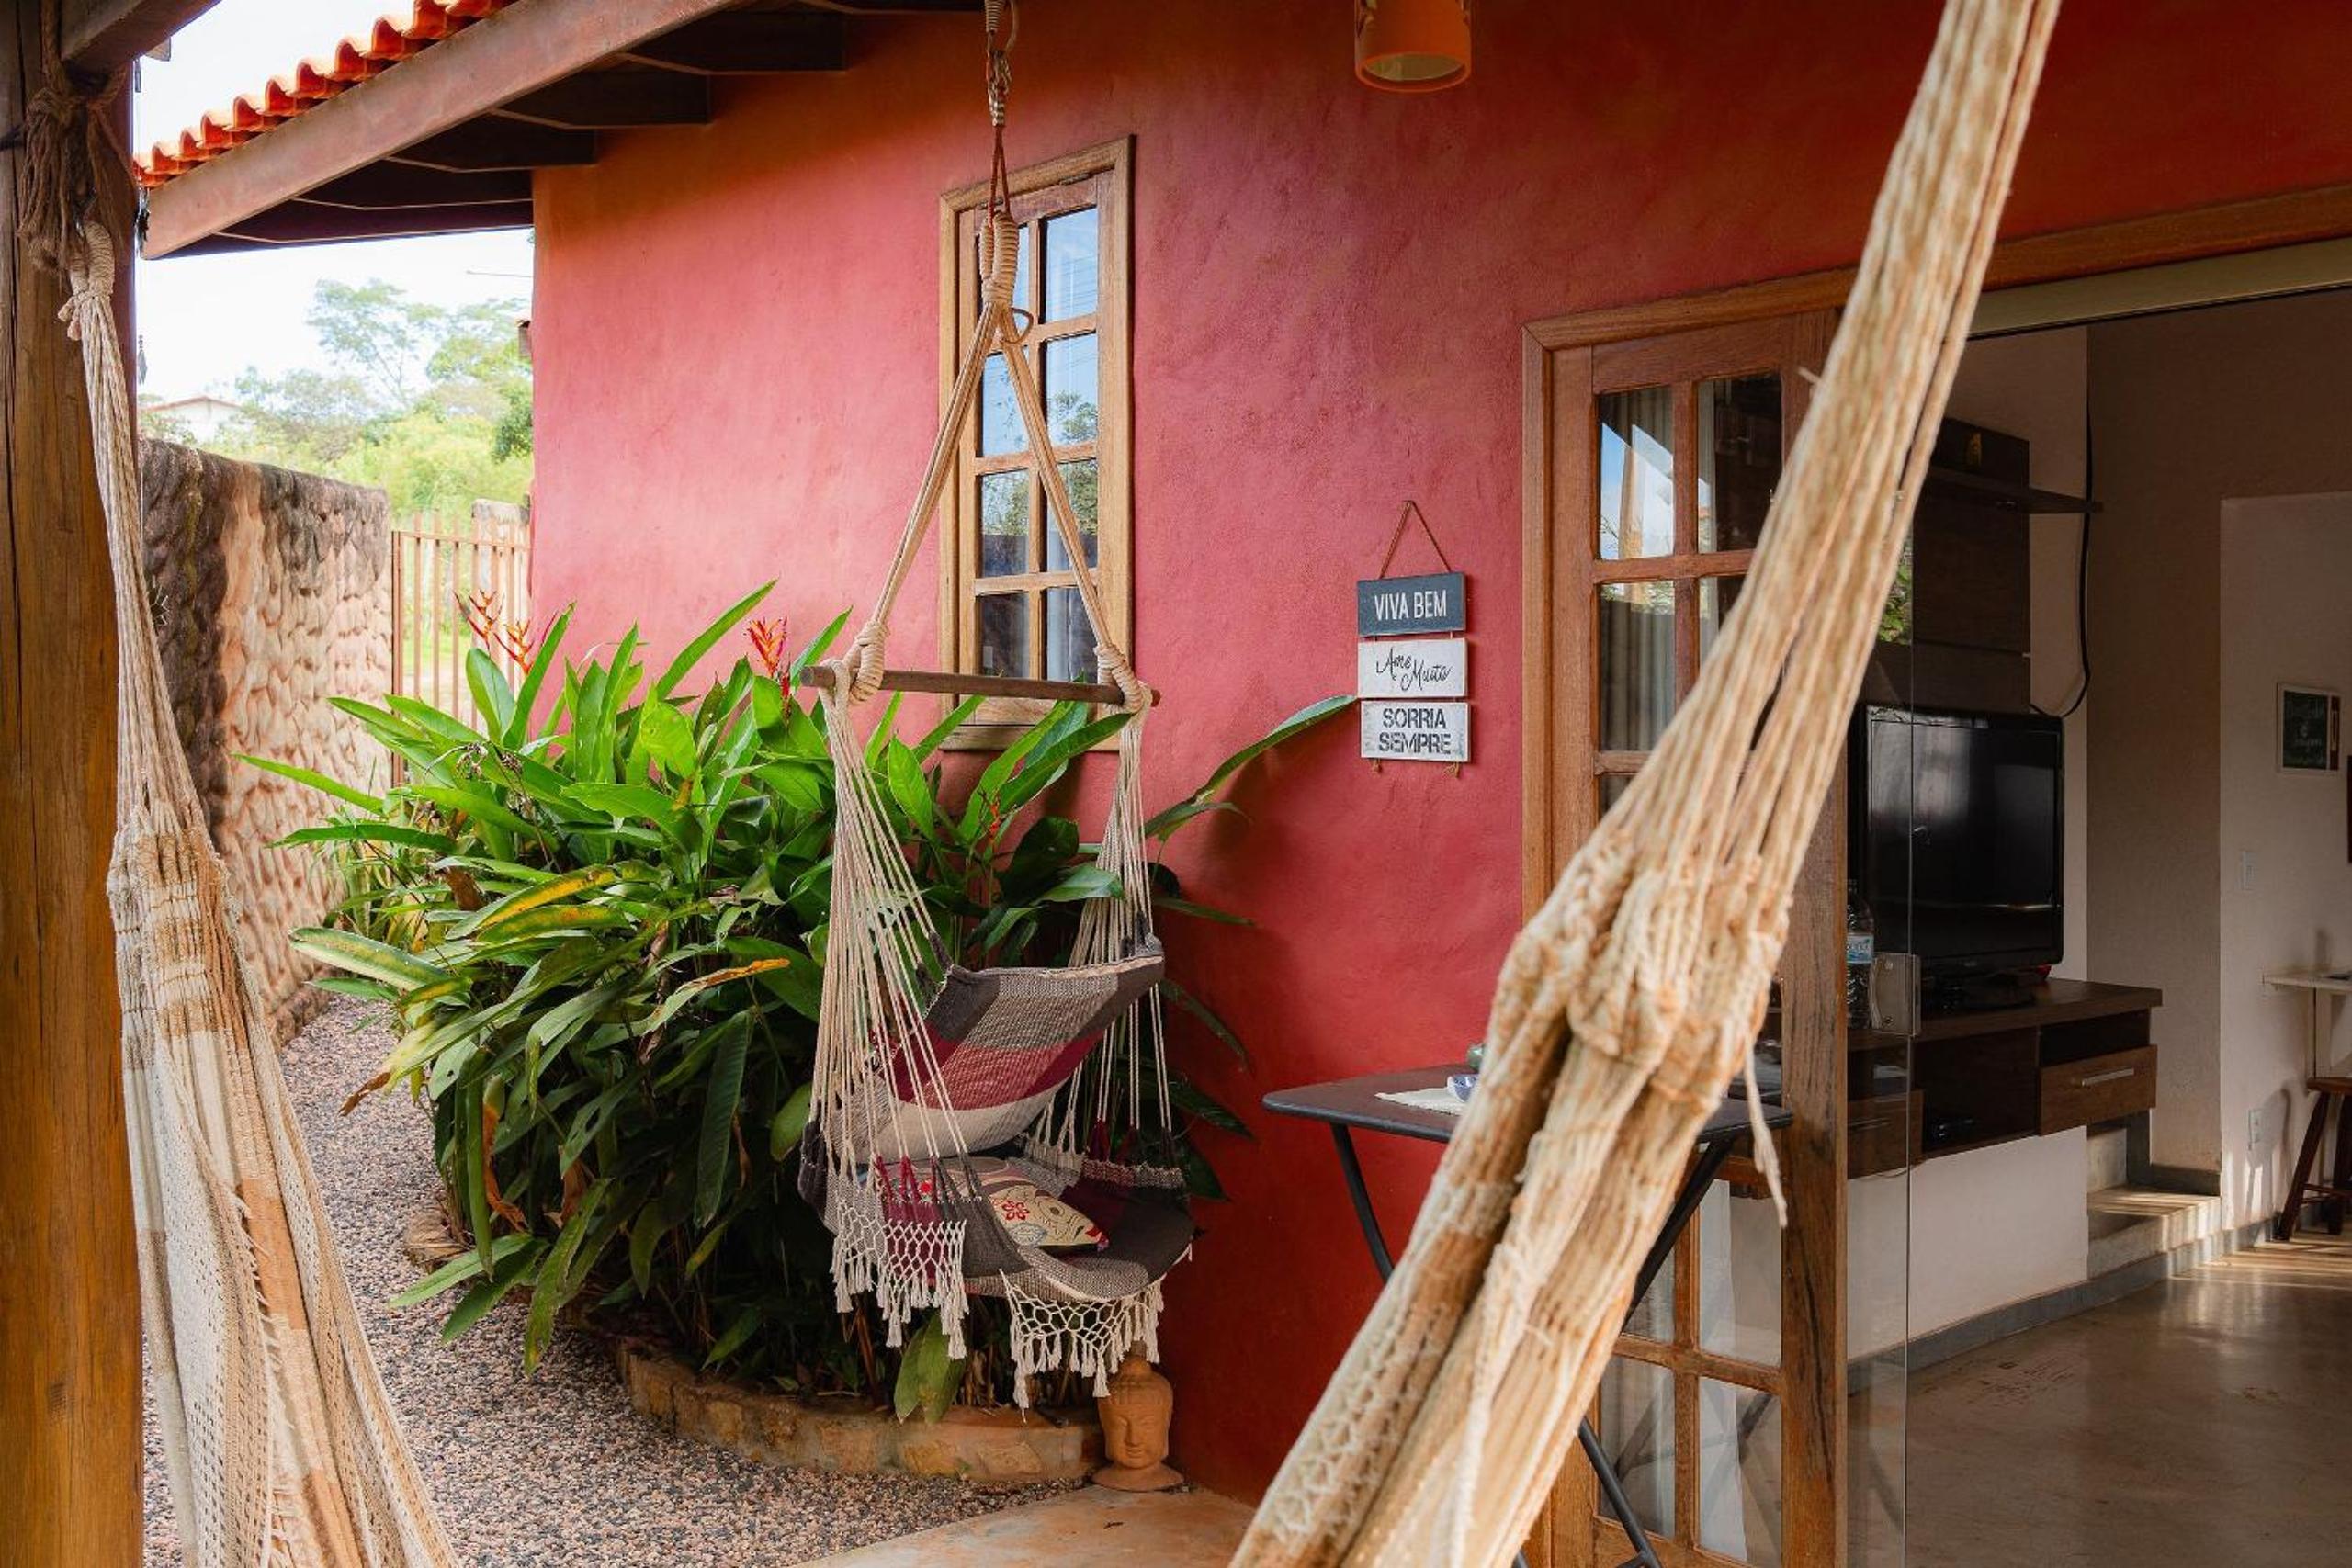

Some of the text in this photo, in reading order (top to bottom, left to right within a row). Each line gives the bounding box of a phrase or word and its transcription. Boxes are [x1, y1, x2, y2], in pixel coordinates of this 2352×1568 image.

[1374, 589, 1447, 621] VIVA BEM
[1375, 645, 1413, 681] Ame
[1382, 707, 1446, 729] SORRIA
[1378, 732, 1452, 755] SEMPRE
